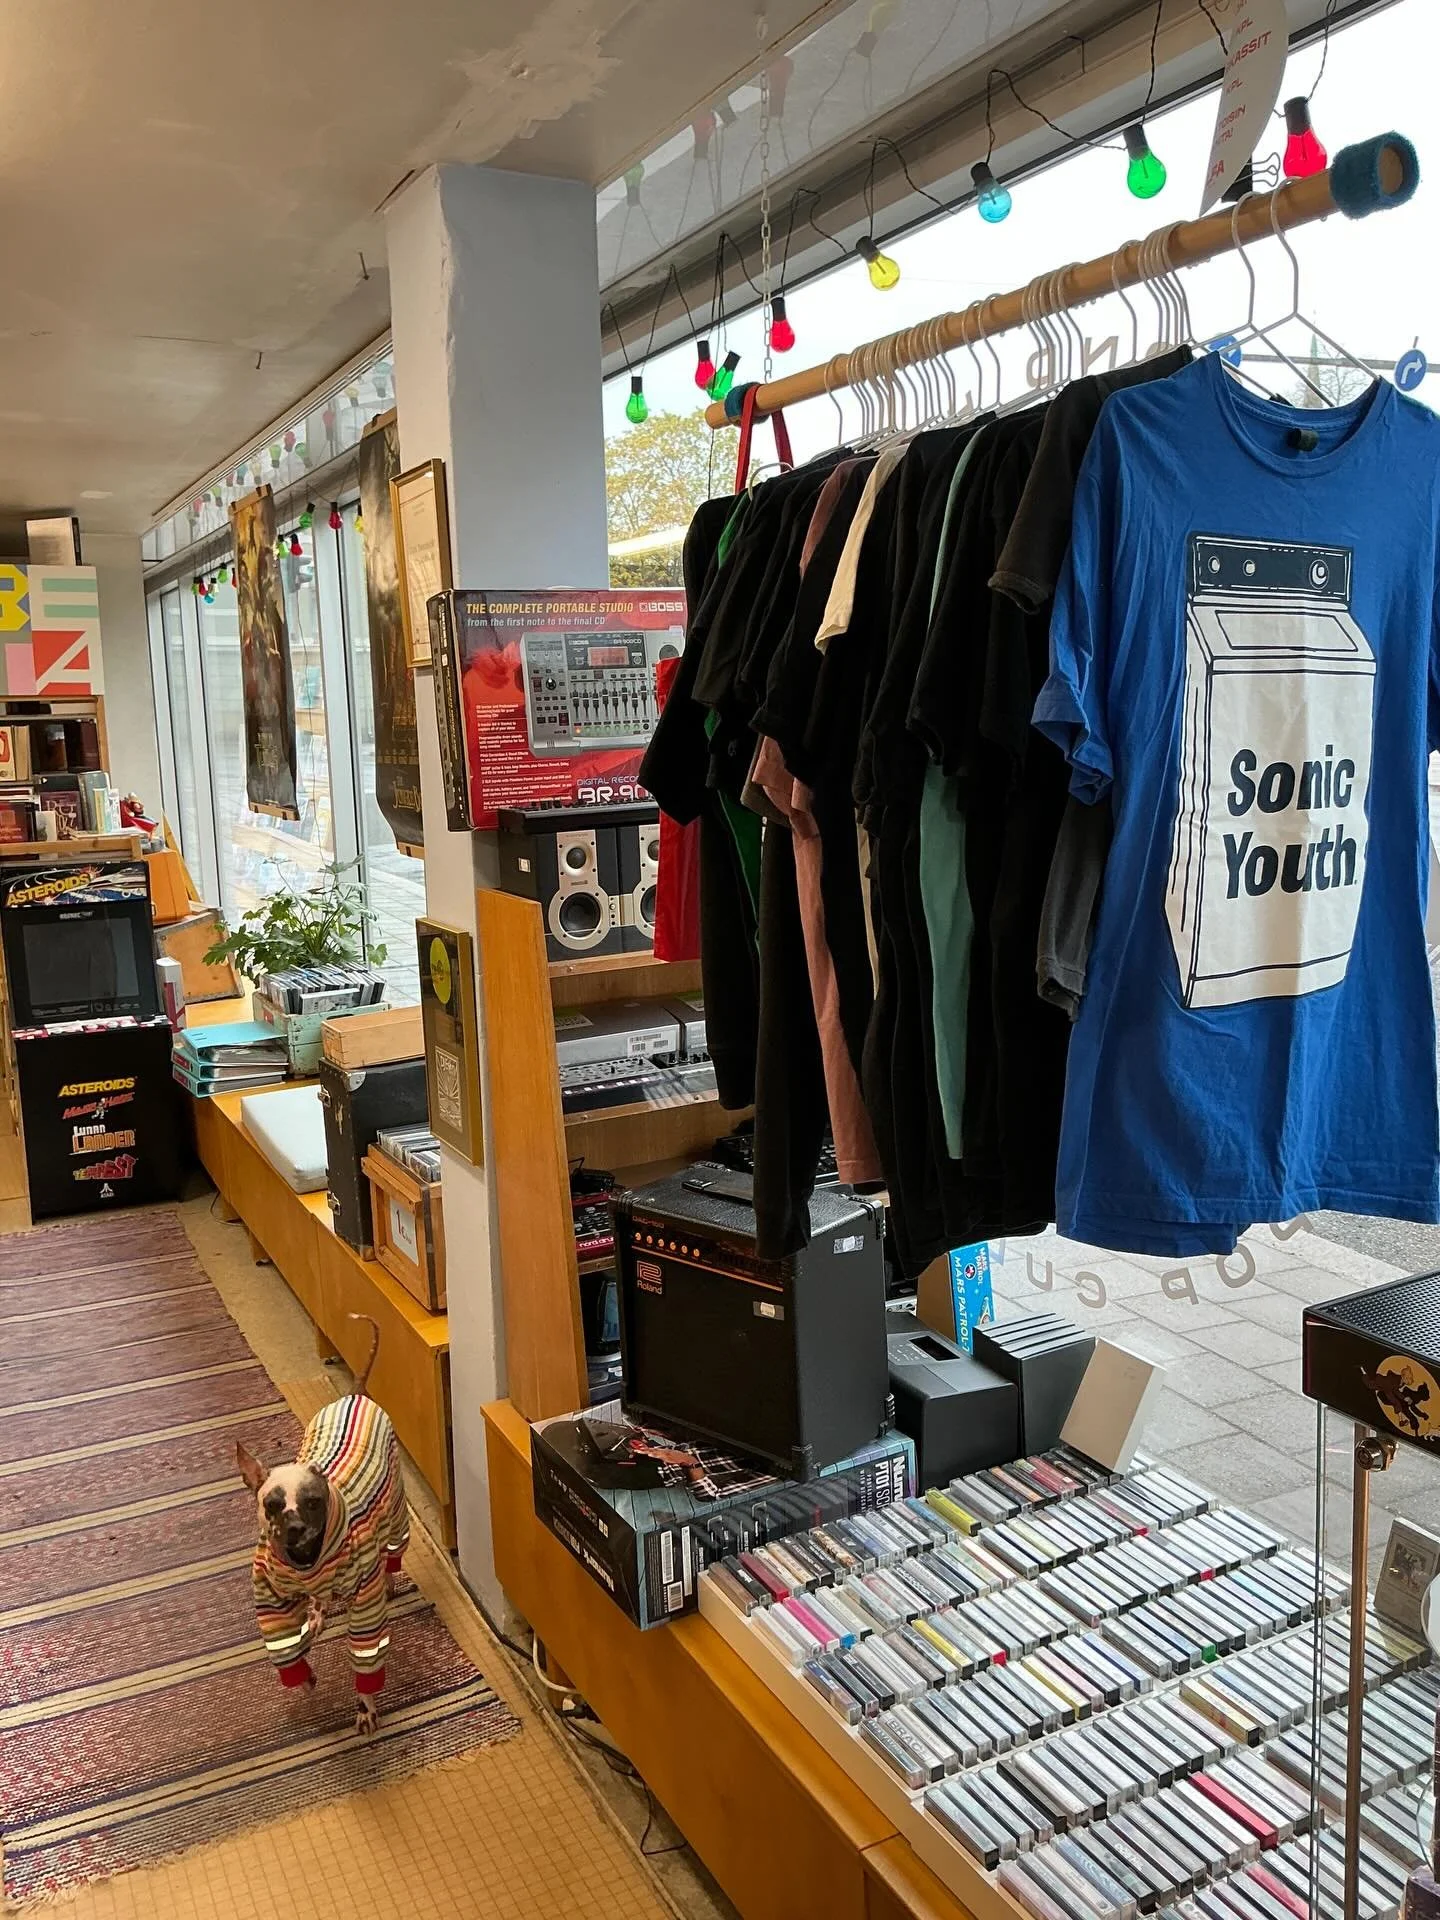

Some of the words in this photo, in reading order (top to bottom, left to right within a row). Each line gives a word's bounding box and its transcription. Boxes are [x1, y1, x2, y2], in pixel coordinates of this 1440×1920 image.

[466, 602, 486, 614] THE
[489, 602, 543, 614] COMPLETE
[545, 602, 596, 613] PORTABLE
[599, 601, 634, 613] STUDIO
[648, 602, 684, 612] BOSS
[467, 617, 488, 627] from
[490, 617, 505, 627] the
[506, 617, 525, 626] first
[527, 617, 545, 626] note
[547, 617, 556, 626] to
[558, 617, 572, 626] the
[573, 616, 592, 626] final
[594, 615, 606, 625] CD
[576, 777, 610, 787] DIGITAL
[1227, 744, 1355, 817] Sonic
[7, 872, 91, 907] ASTEROIDS
[57, 1077, 136, 1098] ASTEROIDS
[579, 1239, 599, 1248] nord
[953, 1255, 966, 1295] MARS
[636, 1279, 663, 1295] Roland
[874, 1460, 891, 1490] PT01
